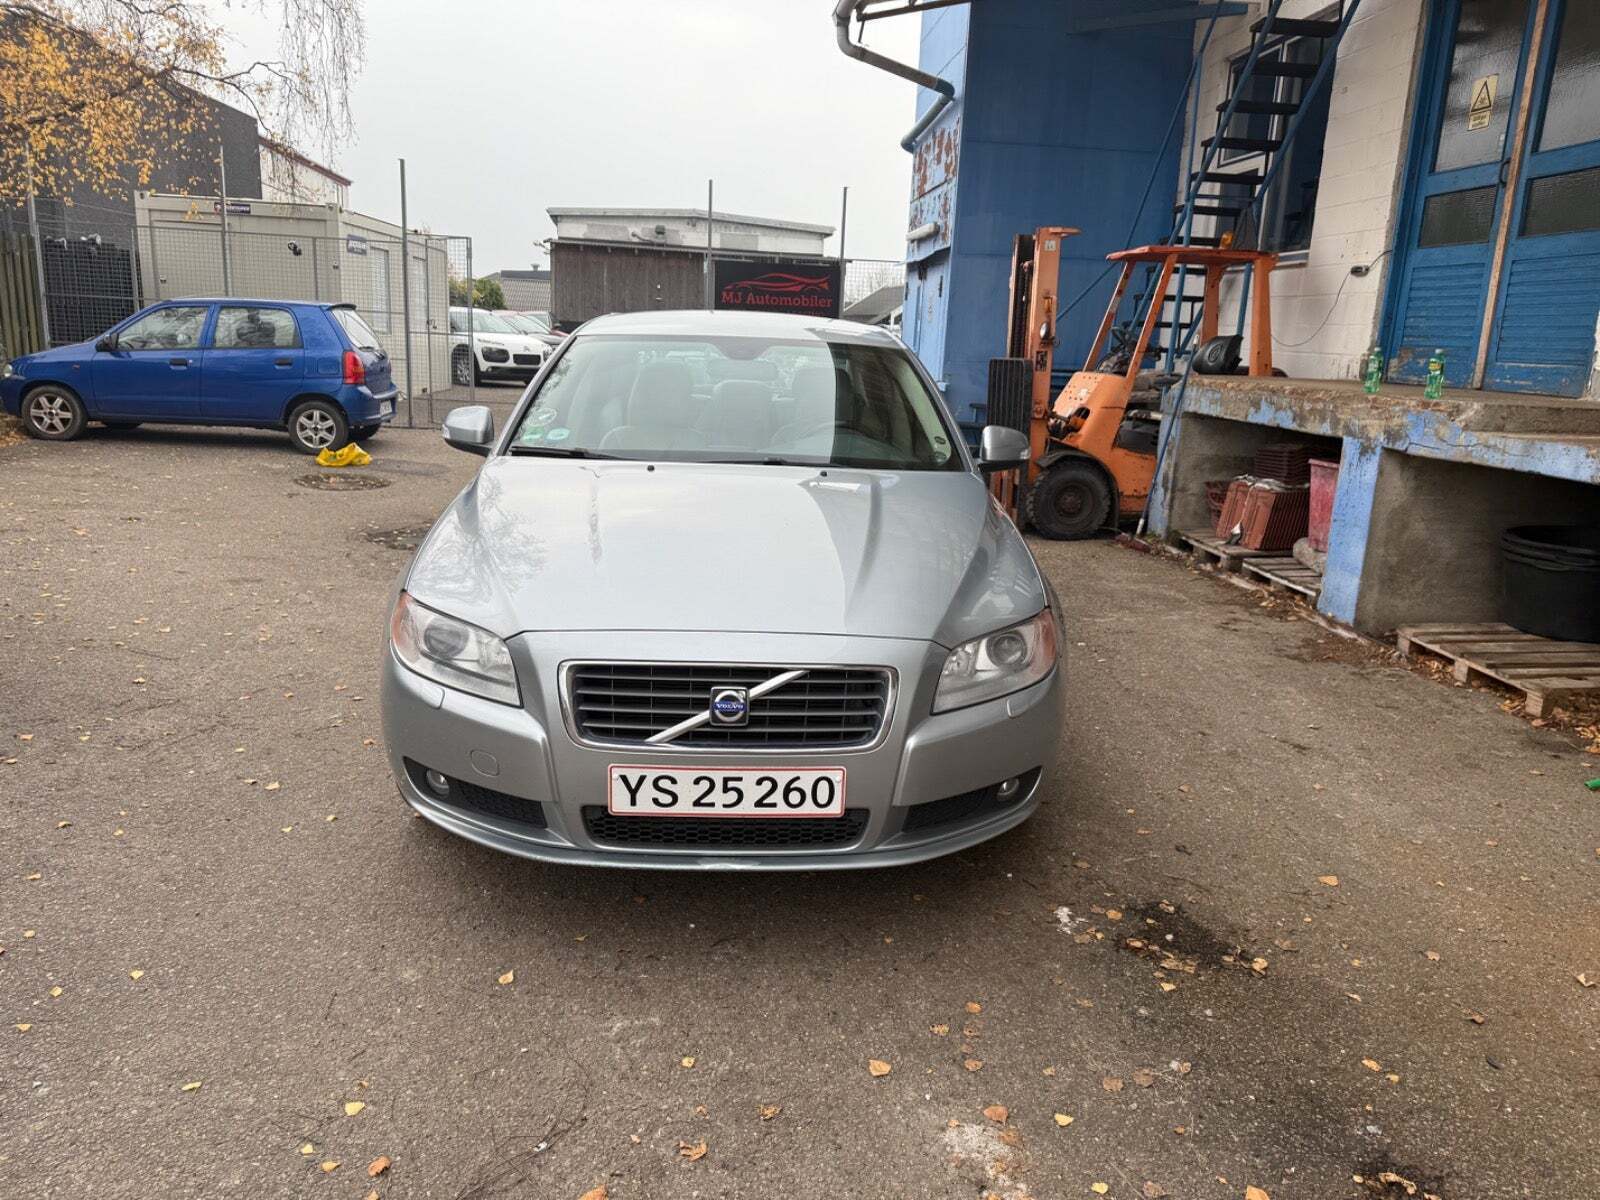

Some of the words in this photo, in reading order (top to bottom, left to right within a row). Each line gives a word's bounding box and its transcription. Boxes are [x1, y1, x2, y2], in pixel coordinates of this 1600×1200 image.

[721, 291, 742, 304] MJ
[747, 292, 832, 308] Automobiler
[619, 774, 679, 807] YS
[692, 775, 744, 808] 25
[753, 776, 835, 809] 260
